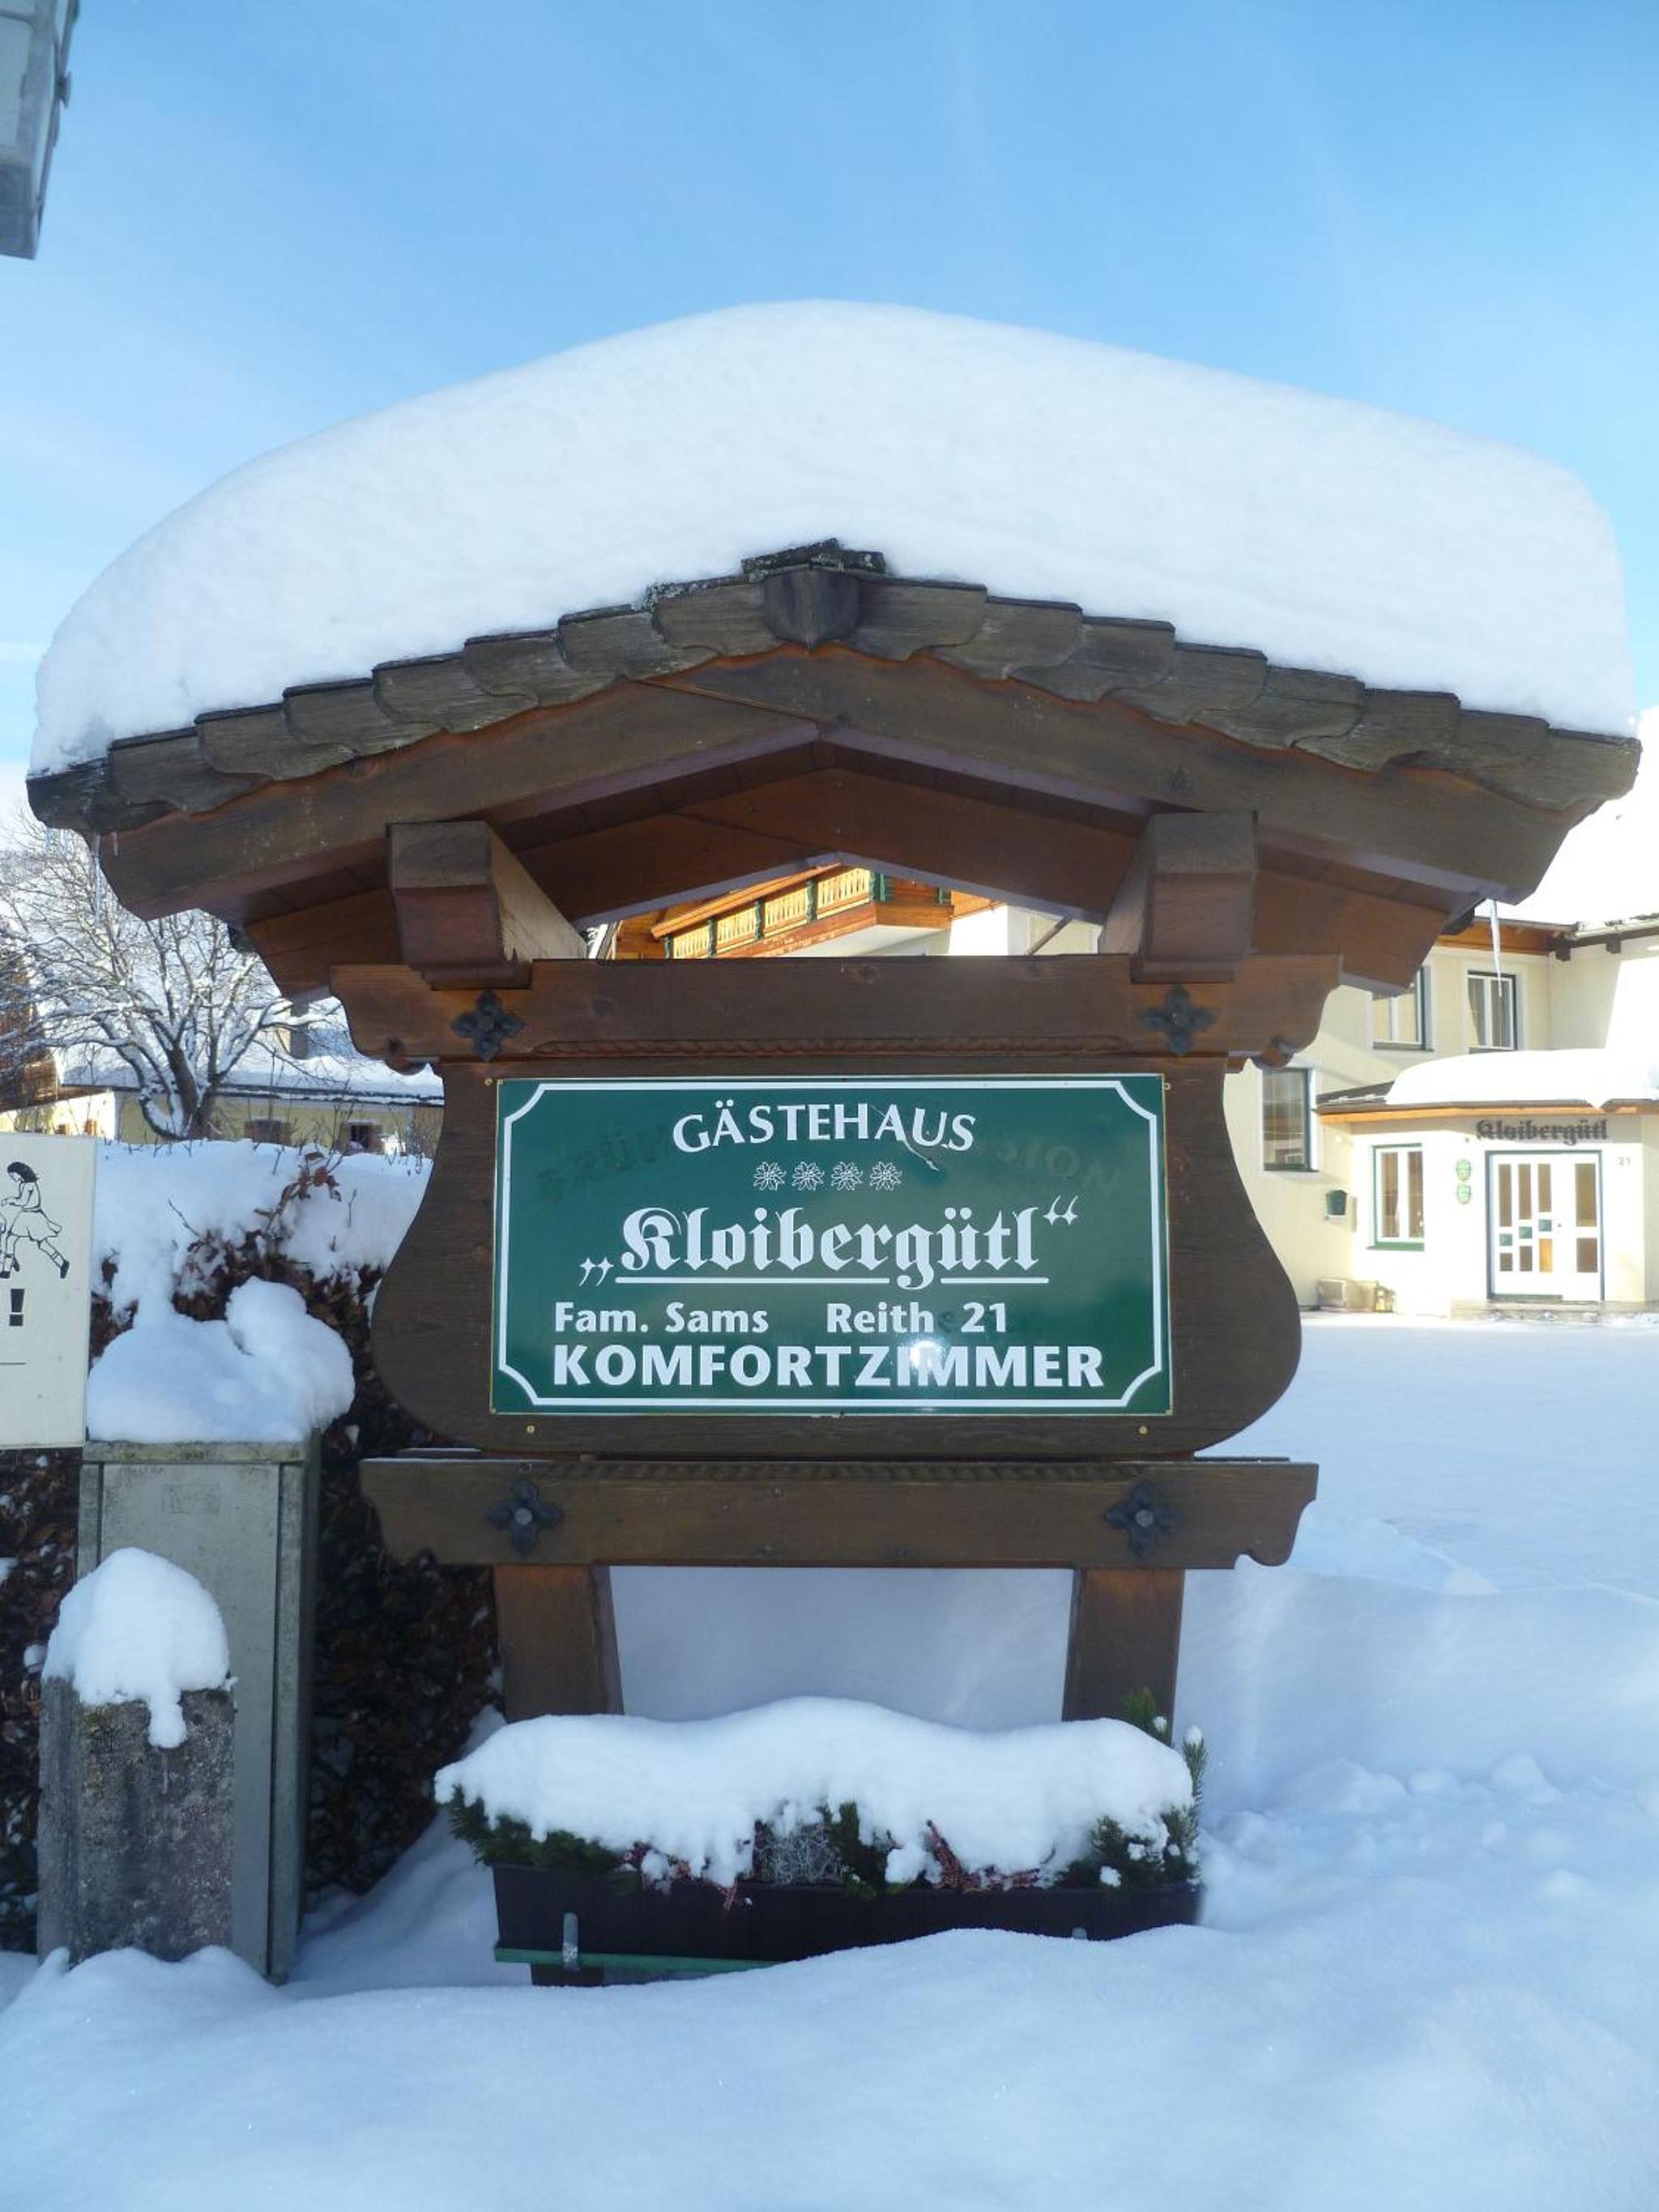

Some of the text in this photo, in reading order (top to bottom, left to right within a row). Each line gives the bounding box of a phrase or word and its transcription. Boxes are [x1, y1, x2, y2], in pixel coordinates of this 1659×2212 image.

[673, 1100, 976, 1153] GÄSTEHAUS
[1475, 1118, 1609, 1146] Kloibergütl
[554, 1301, 1008, 1335] Fam. Sams Reith 21
[553, 1340, 1105, 1388] KOMFORTZIMMER
